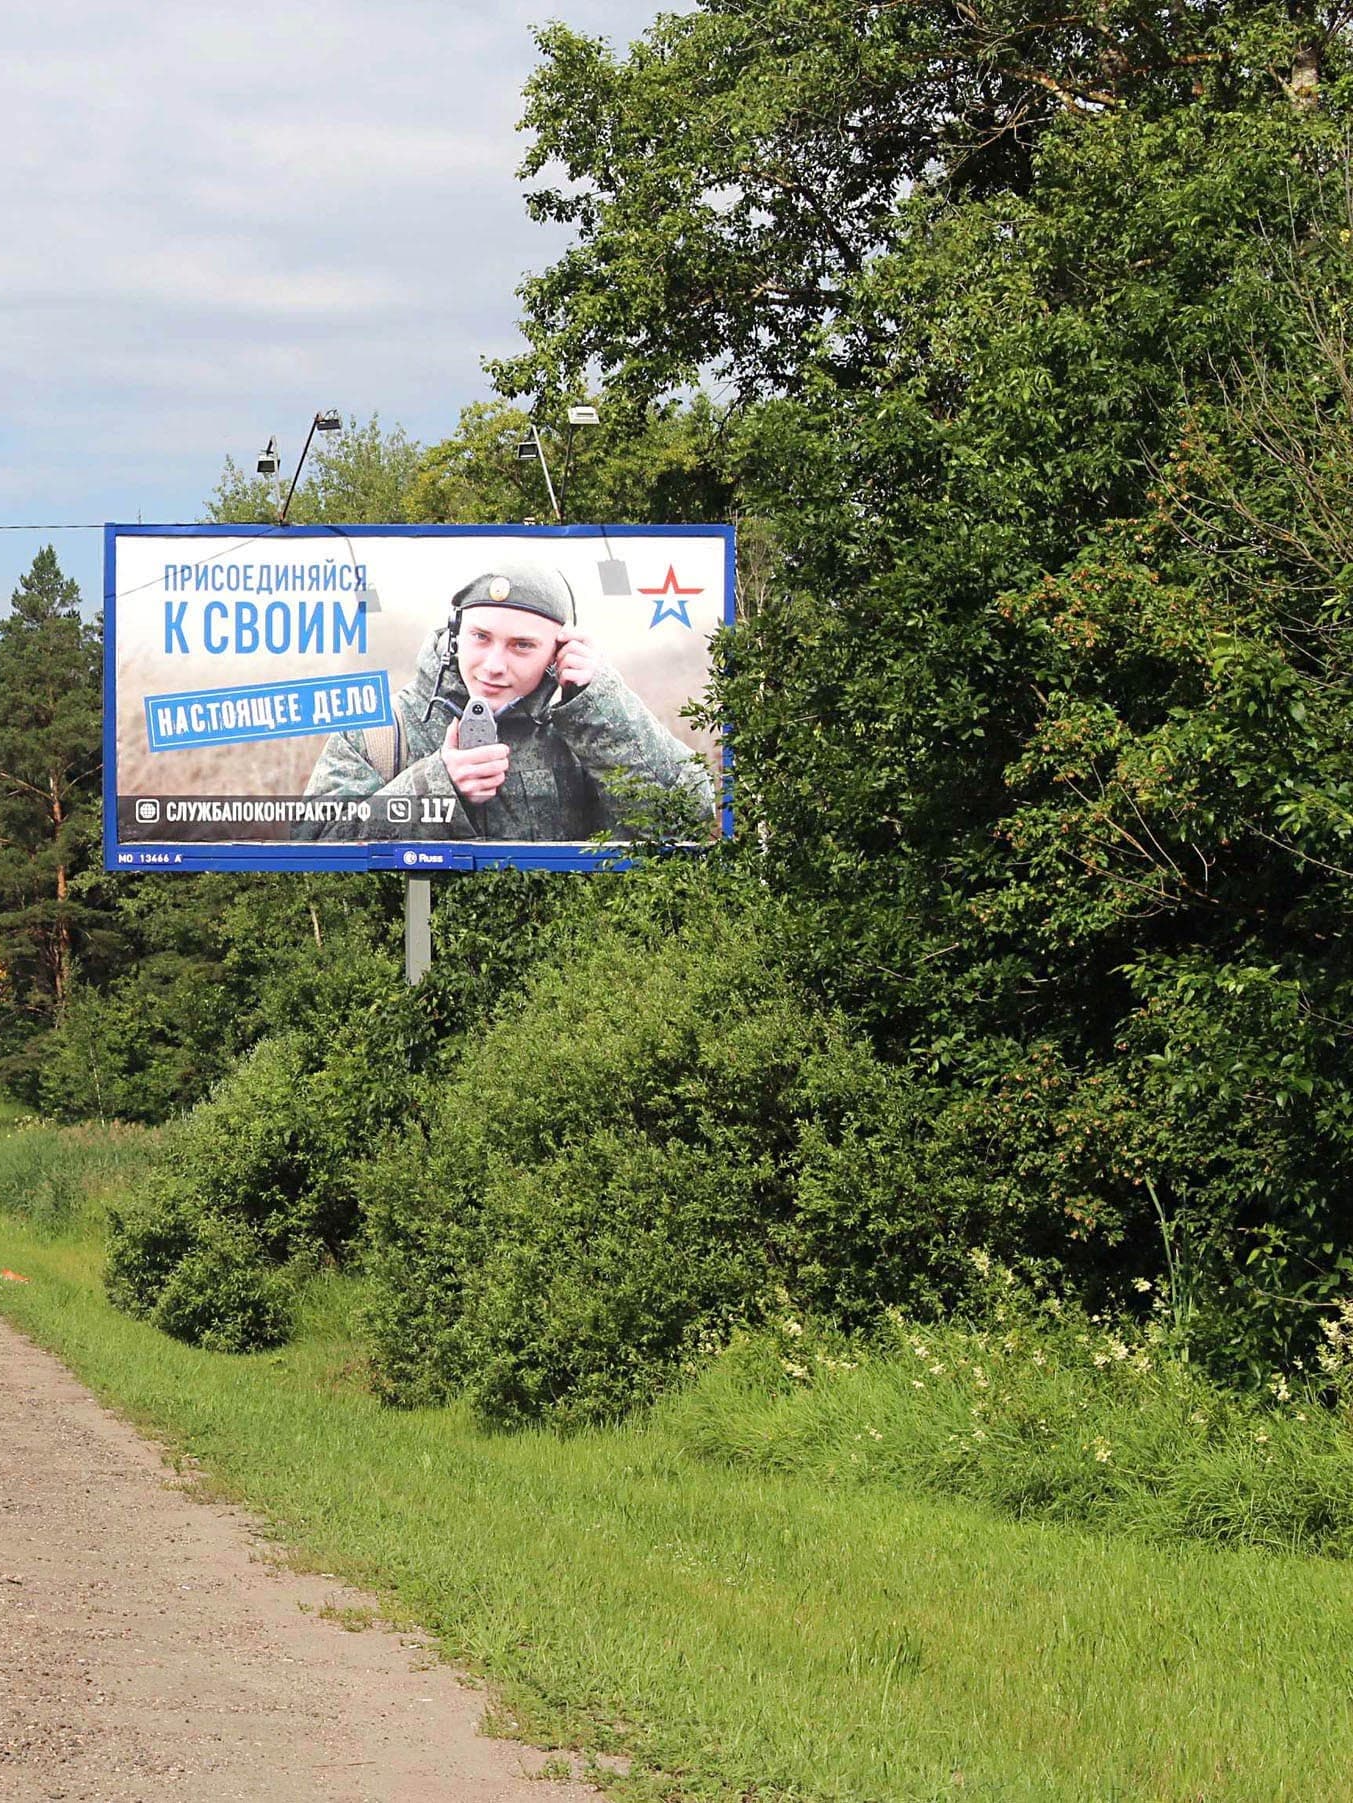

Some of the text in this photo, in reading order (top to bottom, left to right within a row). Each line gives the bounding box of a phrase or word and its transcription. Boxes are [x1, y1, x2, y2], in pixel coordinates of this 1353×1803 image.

[164, 559, 367, 595] ПРИСОЕДИНЯЙСЯ
[164, 600, 367, 655] К СВОИМ
[157, 685, 377, 737] НАСТОЯЩЕЕ ДЕЛО
[166, 800, 371, 822] СЛУЖБАПОКОНТРАКТУ.РФ
[420, 798, 456, 822] 117
[140, 854, 169, 863] 13466
